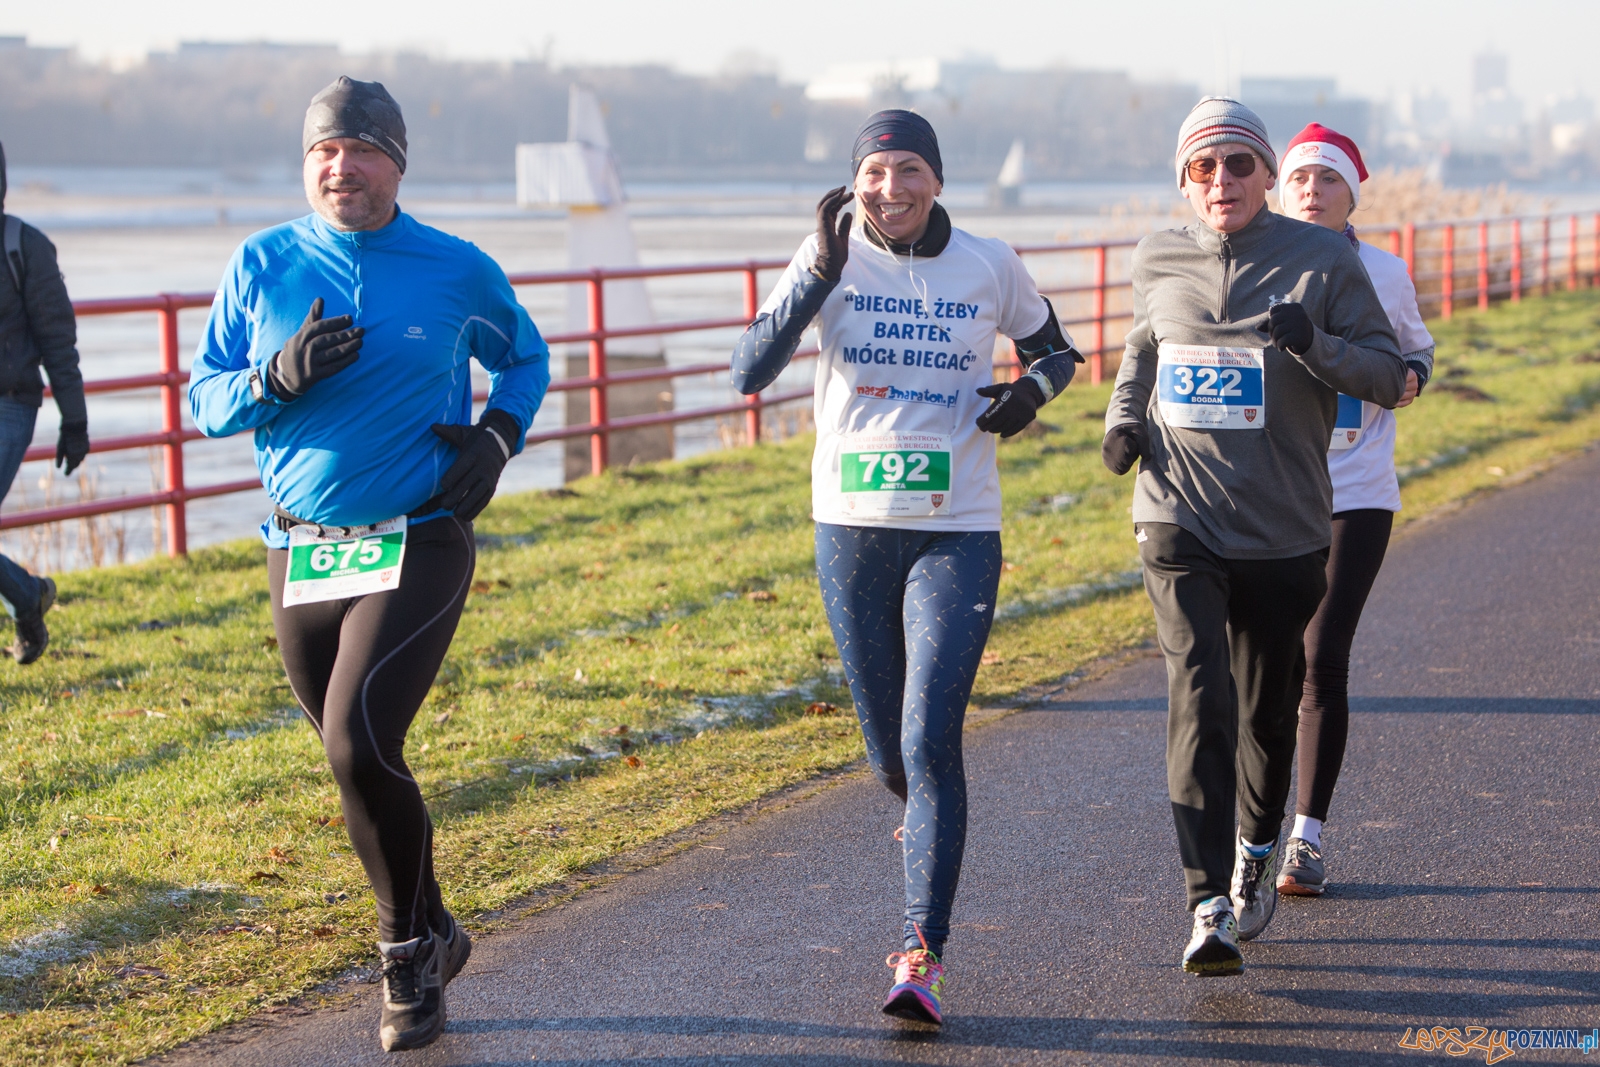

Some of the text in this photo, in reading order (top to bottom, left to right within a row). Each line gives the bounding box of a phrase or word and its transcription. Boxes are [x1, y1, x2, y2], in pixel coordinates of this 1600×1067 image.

[934, 297, 979, 320] ŻEBY
[873, 321, 952, 343] BARTEK
[843, 342, 897, 365] MÓGŁ
[1173, 366, 1242, 397] 322
[1191, 396, 1223, 404] BOGDAN
[866, 442, 902, 450] RYSZARDA
[903, 442, 940, 450] BURGIELA
[889, 435, 943, 443] SYLWESTROWY
[858, 452, 930, 482] 792
[880, 482, 906, 490] ANETA
[310, 537, 383, 572] 675
